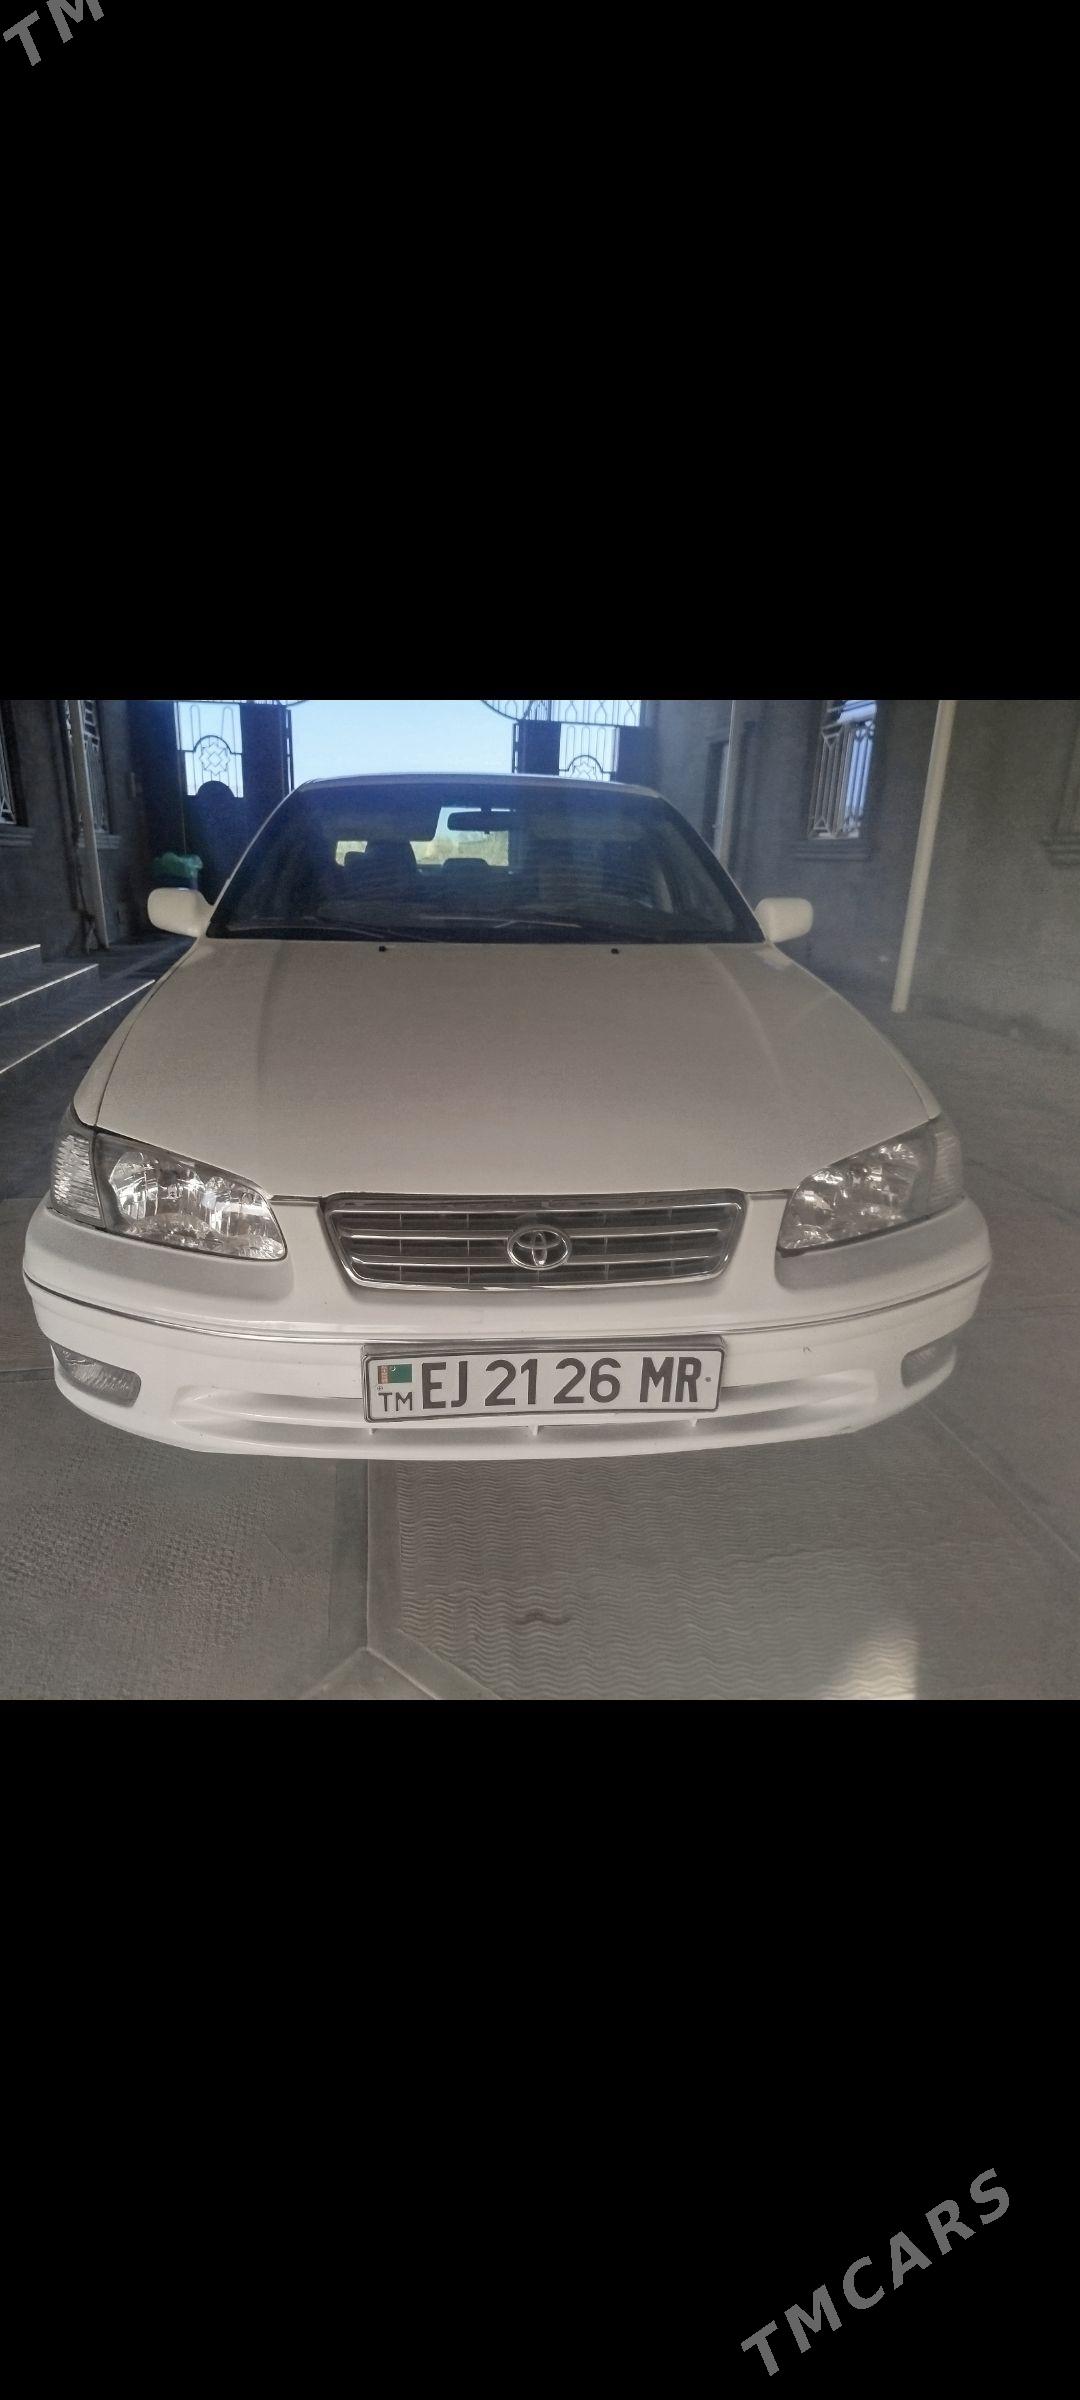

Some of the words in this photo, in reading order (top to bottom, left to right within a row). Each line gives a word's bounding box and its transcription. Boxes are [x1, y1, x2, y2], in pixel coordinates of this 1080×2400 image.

[421, 1360, 468, 1409] EJ
[639, 1356, 702, 1403] MR
[377, 1391, 413, 1412] TM
